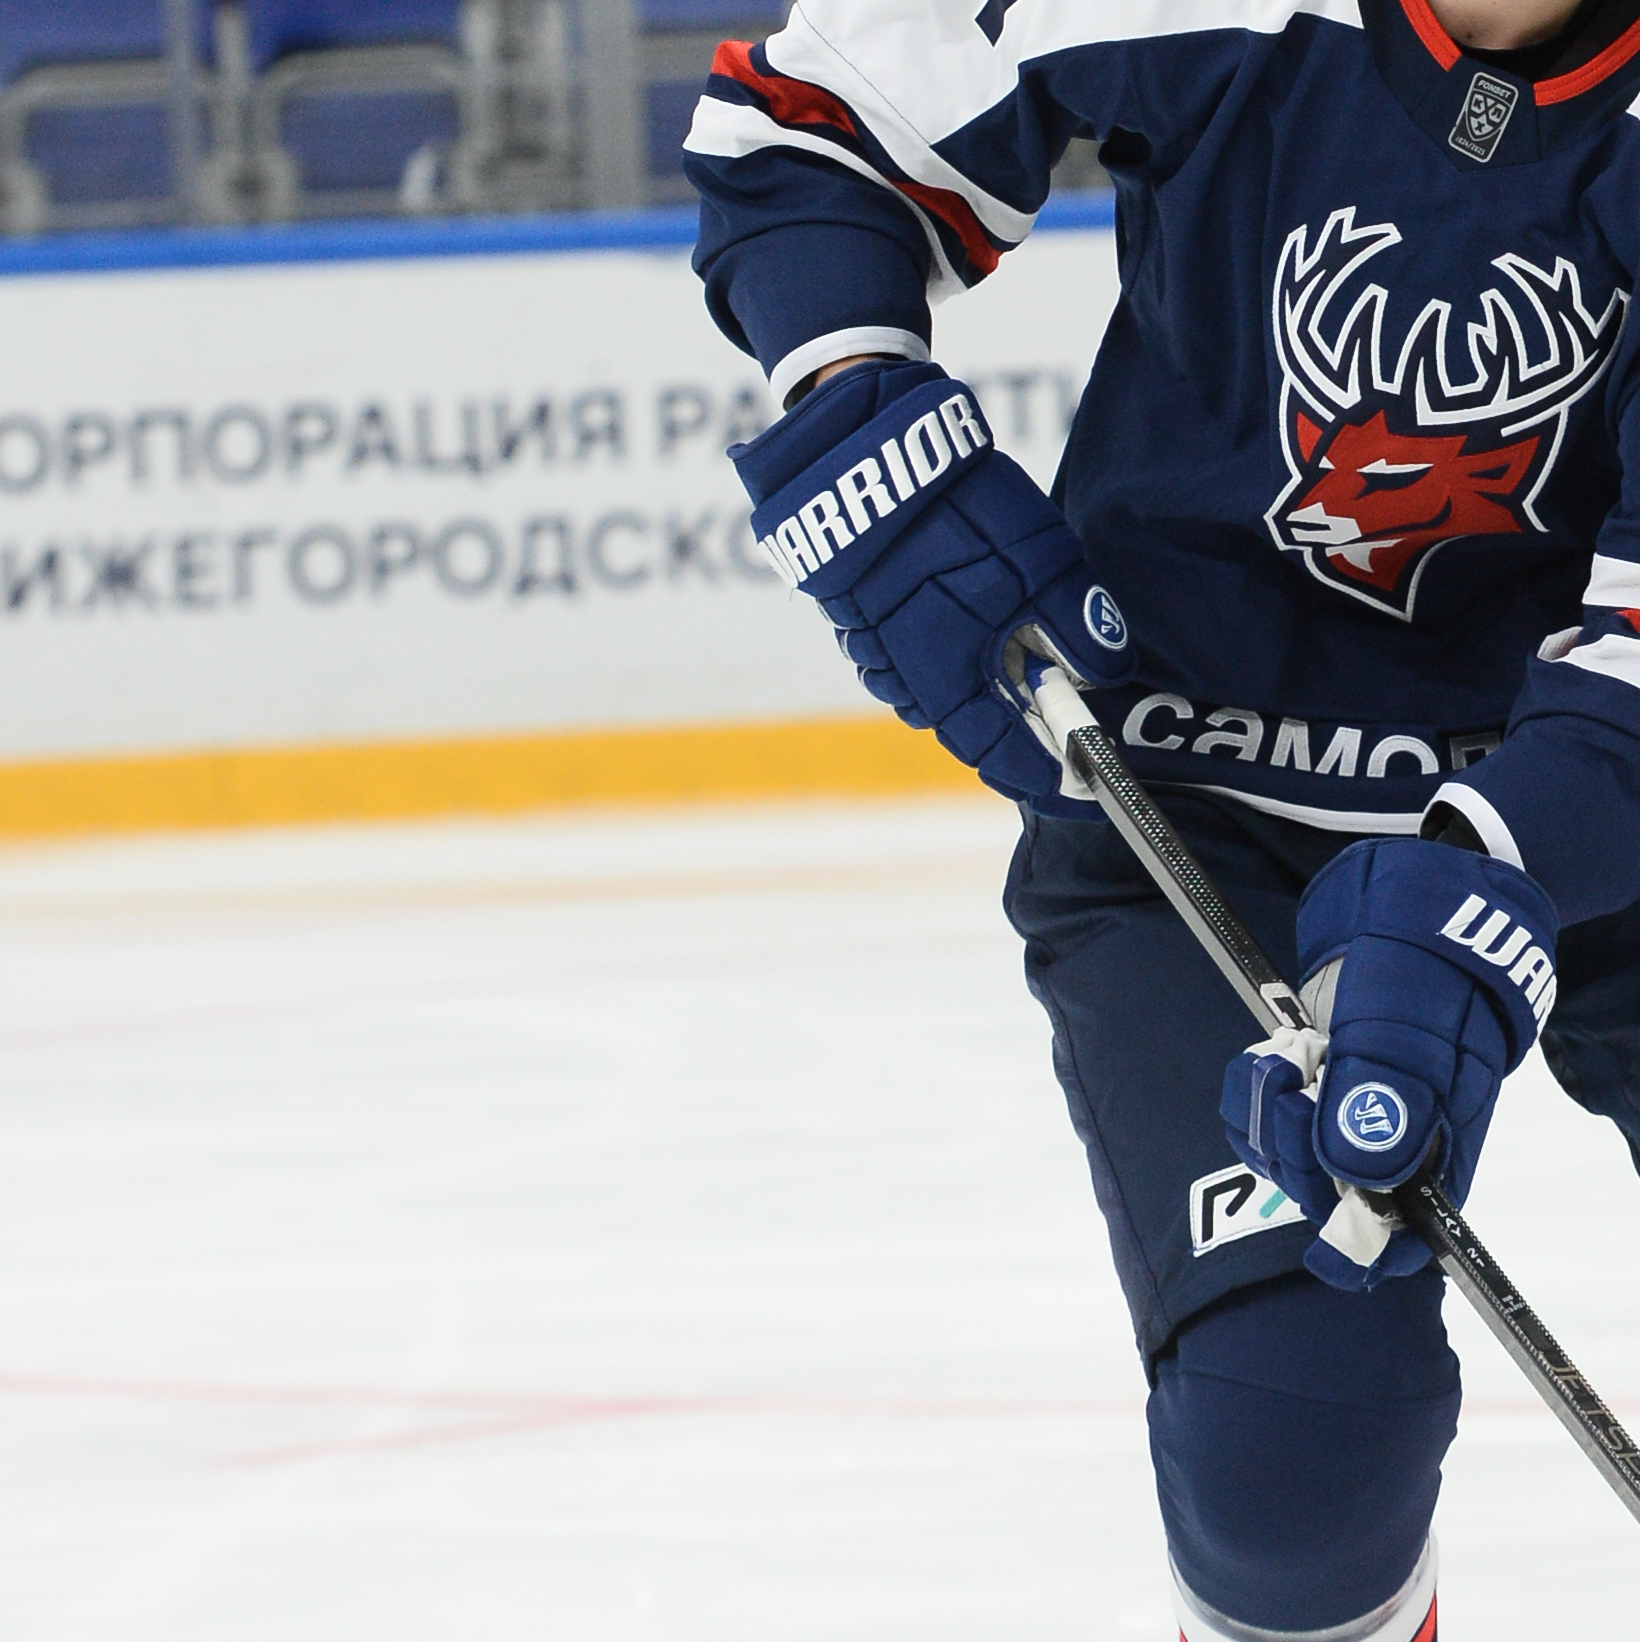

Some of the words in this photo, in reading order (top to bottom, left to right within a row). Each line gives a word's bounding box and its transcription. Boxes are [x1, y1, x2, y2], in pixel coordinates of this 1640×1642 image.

[1478, 80, 1512, 99] FONBET
[0, 383, 624, 493] ОРПОРАЦИЯ
[1420, 1186, 1462, 1238] SILAY
[1467, 1247, 1486, 1268] 21
